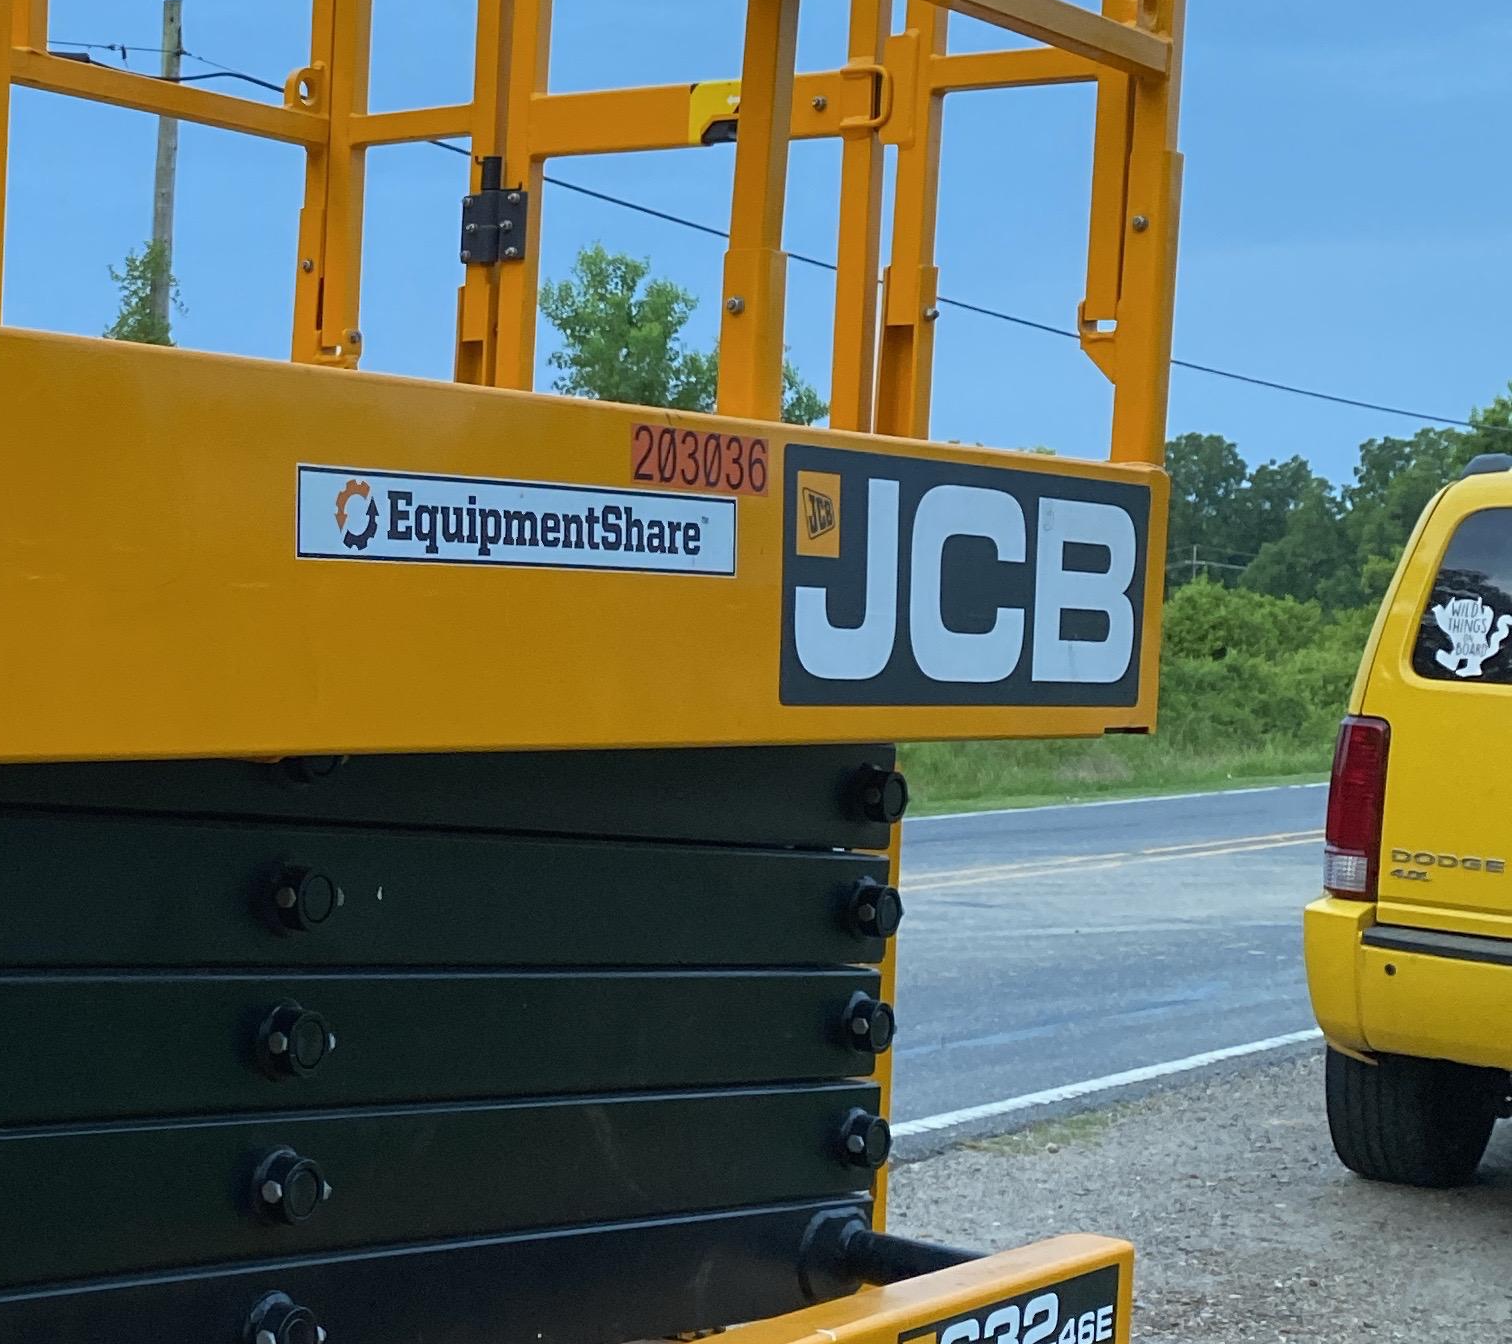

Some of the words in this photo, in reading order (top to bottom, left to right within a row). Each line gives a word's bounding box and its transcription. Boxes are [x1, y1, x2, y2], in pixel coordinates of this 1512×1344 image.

[633, 425, 766, 493] 203036
[387, 490, 701, 556] EquipmentShare
[808, 493, 834, 534] JCB
[795, 478, 1137, 684] JCB
[1448, 617, 1487, 634] THINGS
[1451, 602, 1479, 618] WILD
[1455, 642, 1487, 656] BOARD
[1391, 849, 1505, 873] DODGE
